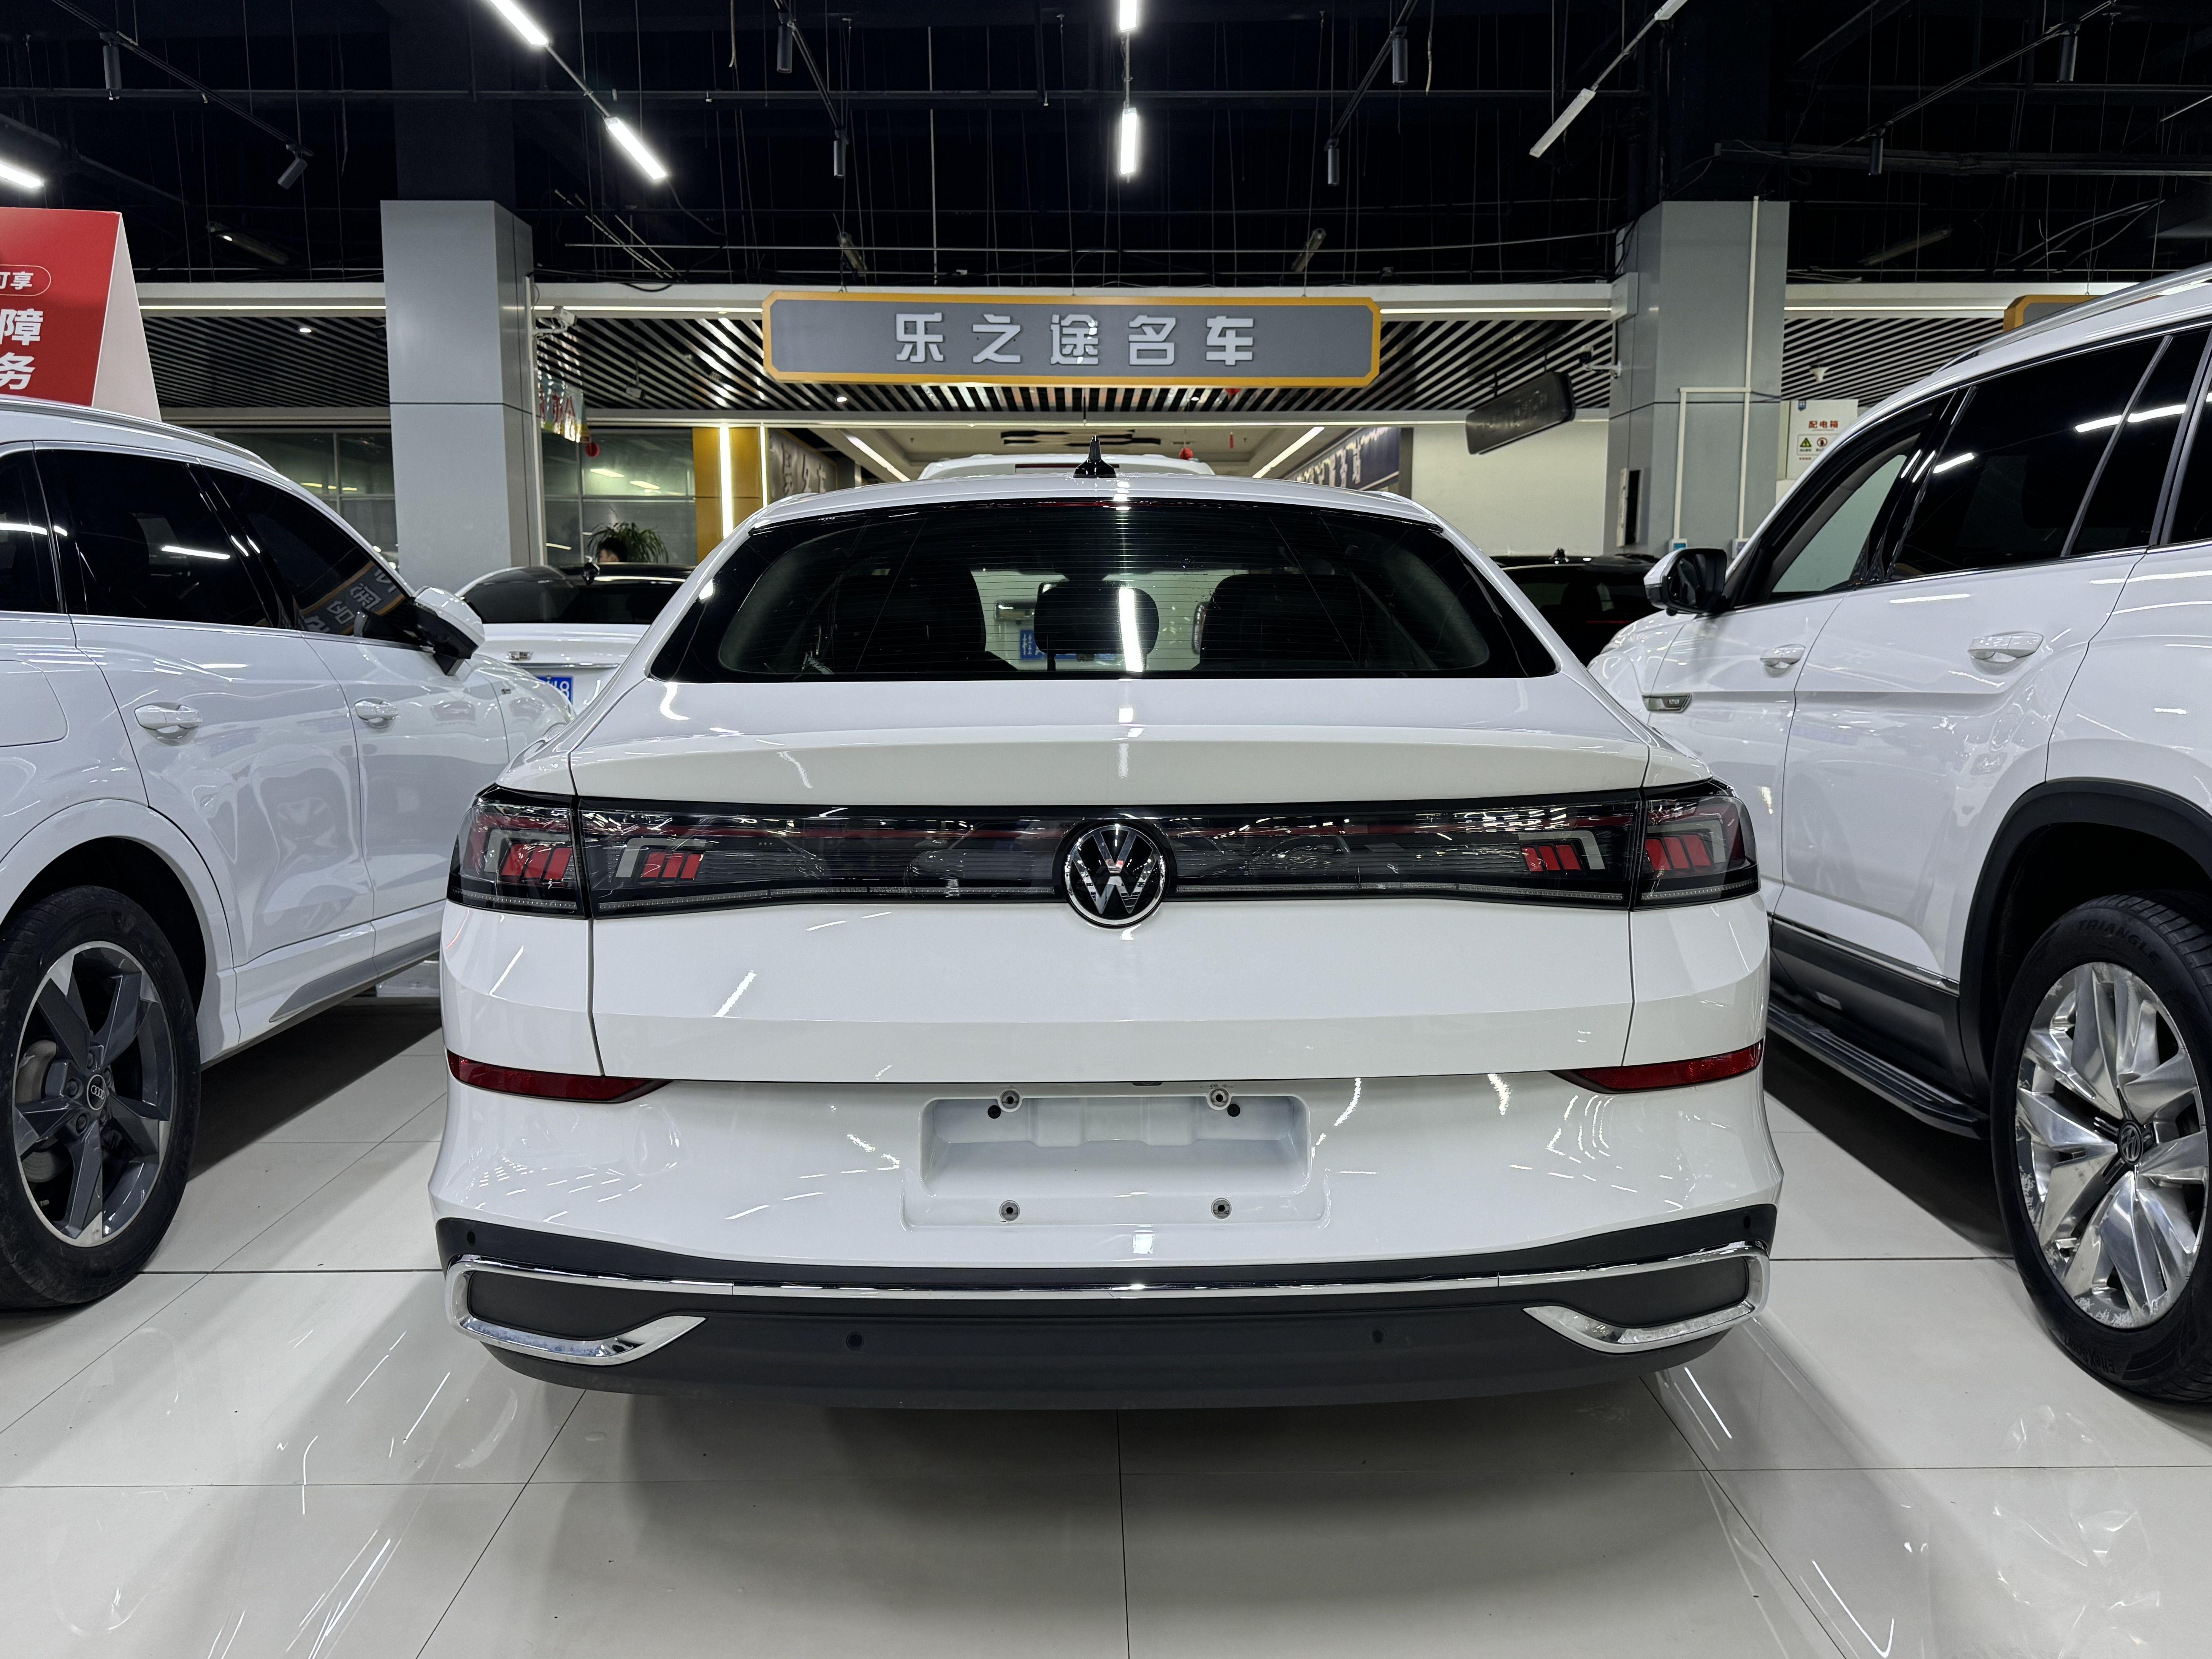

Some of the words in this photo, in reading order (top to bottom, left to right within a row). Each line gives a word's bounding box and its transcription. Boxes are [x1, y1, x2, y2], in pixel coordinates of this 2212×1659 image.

[895, 312, 1254, 366] 乐之途名车
[0, 352, 36, 390] 务
[1809, 420, 1838, 429] 配电箱
[2078, 919, 2162, 965] TRIANGLE
